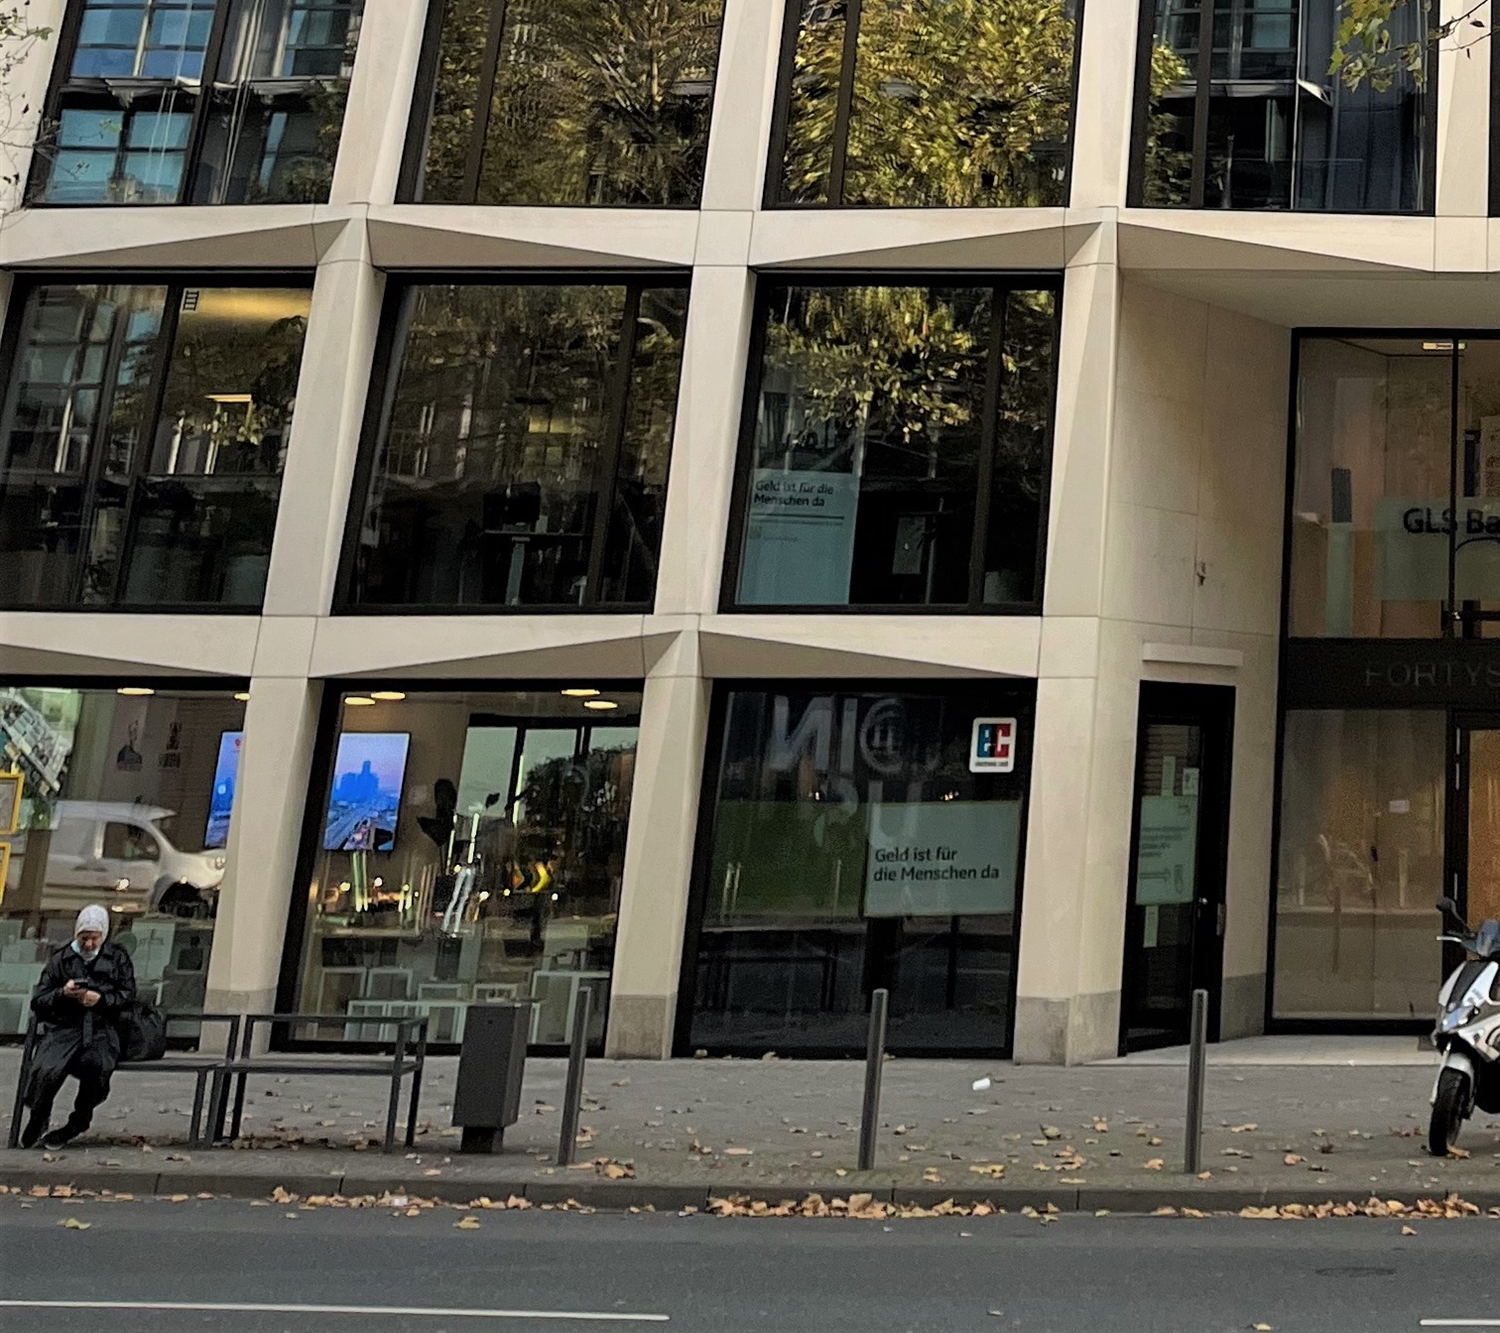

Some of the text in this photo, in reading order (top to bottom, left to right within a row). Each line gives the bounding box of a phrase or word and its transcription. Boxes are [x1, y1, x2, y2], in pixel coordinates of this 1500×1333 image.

[755, 480, 780, 492] Geld
[817, 483, 834, 495] die
[754, 493, 825, 507] Menschen da
[1403, 507, 1458, 534] GLS
[875, 846, 958, 862] Geld ist für
[873, 865, 1000, 882] die Menschen da
